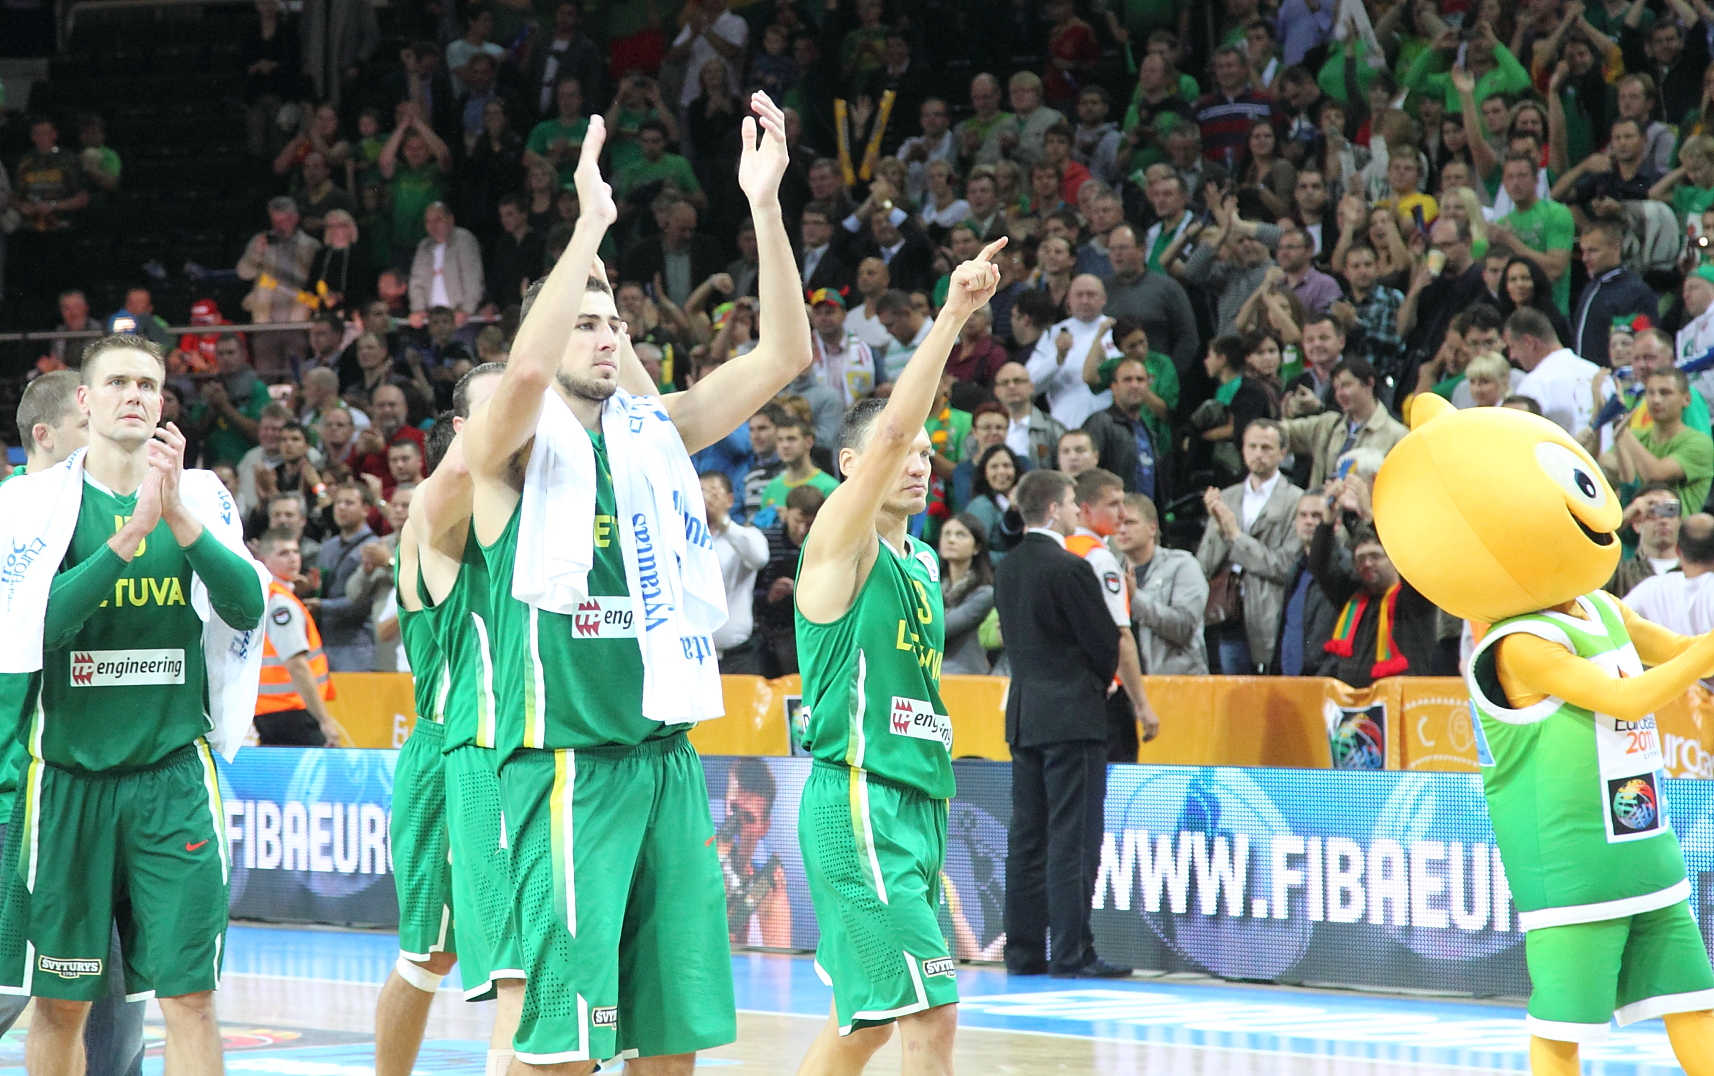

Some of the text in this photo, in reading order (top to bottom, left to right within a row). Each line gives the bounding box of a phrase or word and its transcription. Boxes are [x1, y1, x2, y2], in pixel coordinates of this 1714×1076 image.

[99, 577, 186, 607] TUVA
[604, 610, 634, 630] eng
[96, 656, 182, 679] engineering
[1625, 731, 1655, 755] 2011
[222, 800, 394, 875] FIBAEUR
